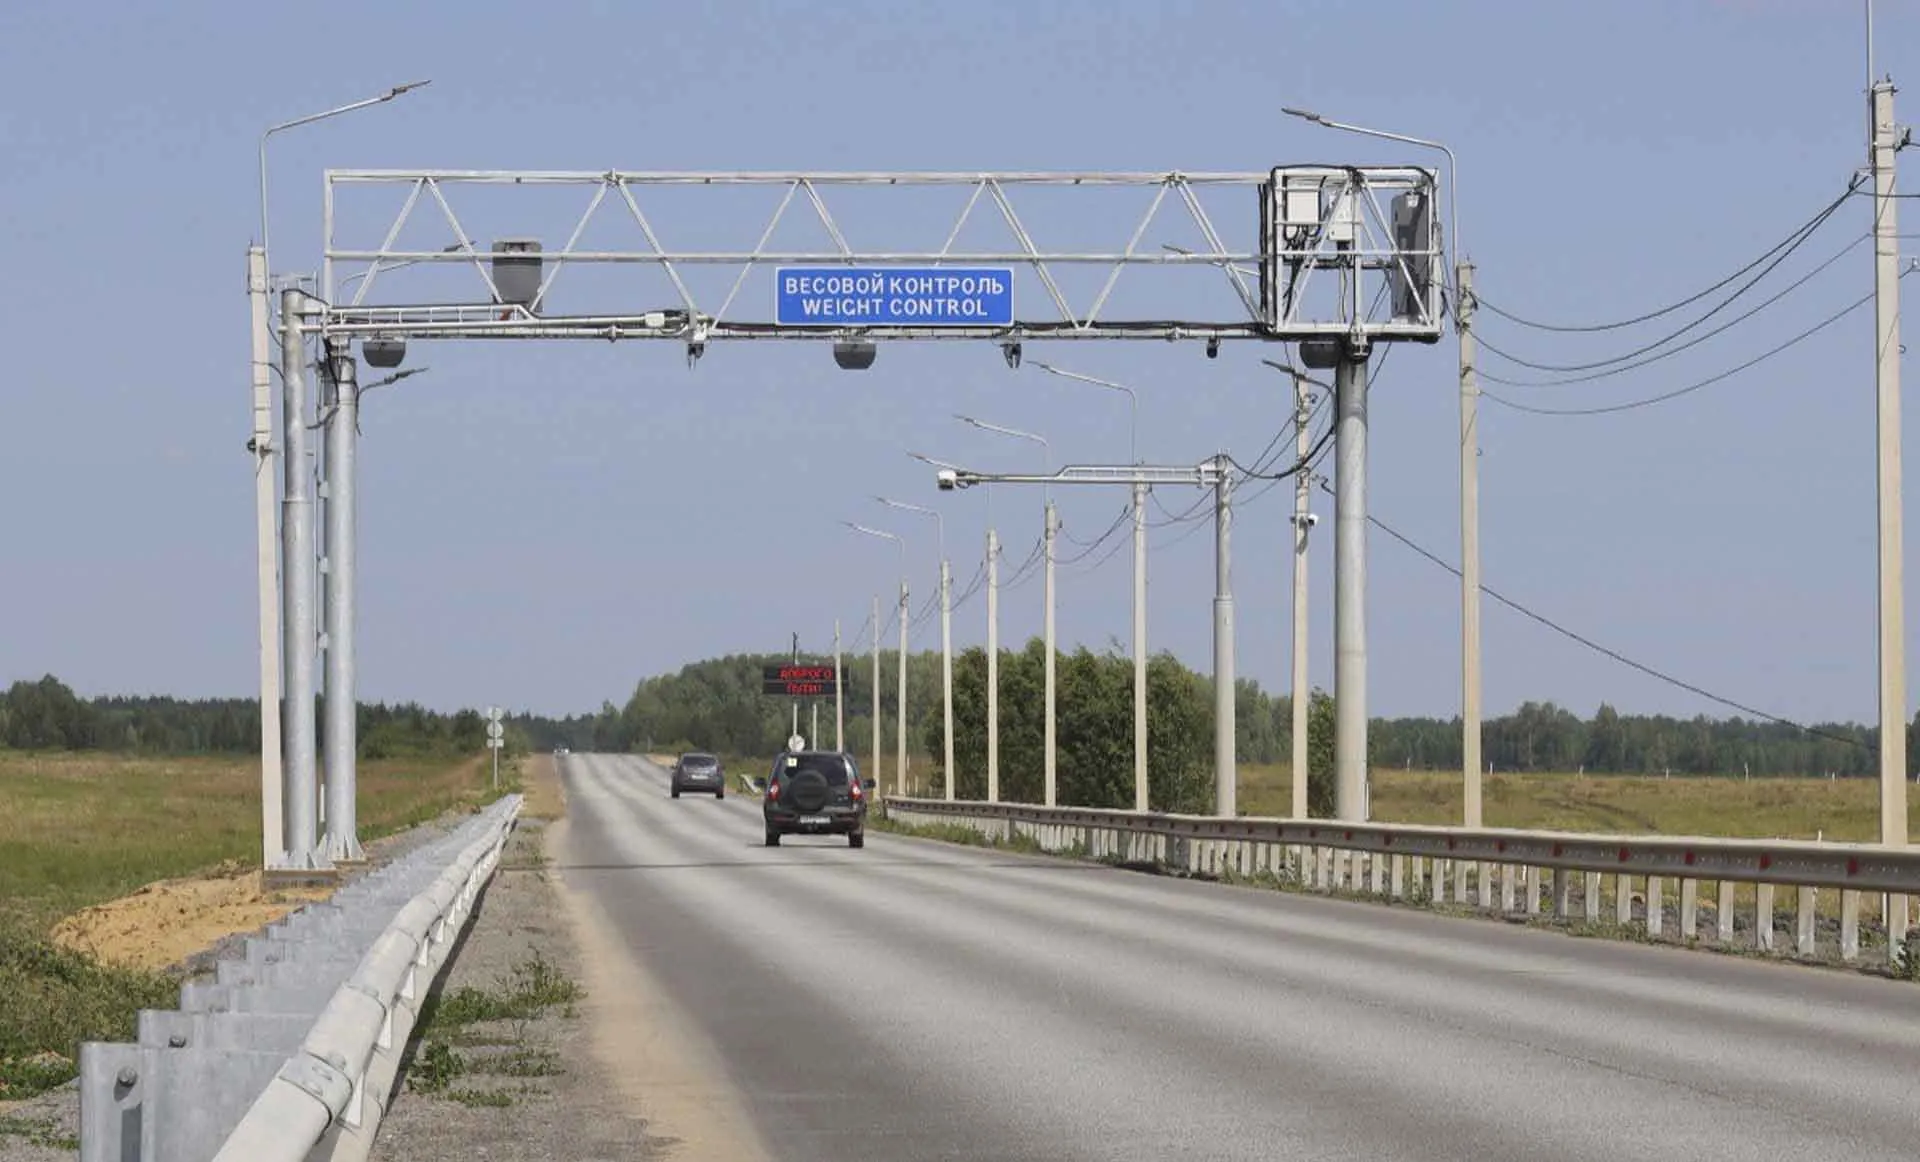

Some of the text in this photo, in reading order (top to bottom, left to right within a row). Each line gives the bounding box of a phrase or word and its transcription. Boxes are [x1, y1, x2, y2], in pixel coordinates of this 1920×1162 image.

[785, 273, 1004, 296] ВЕСОВОЙ КОНТРОЛЬ
[802, 298, 988, 316] WEIGHT CONTROL
